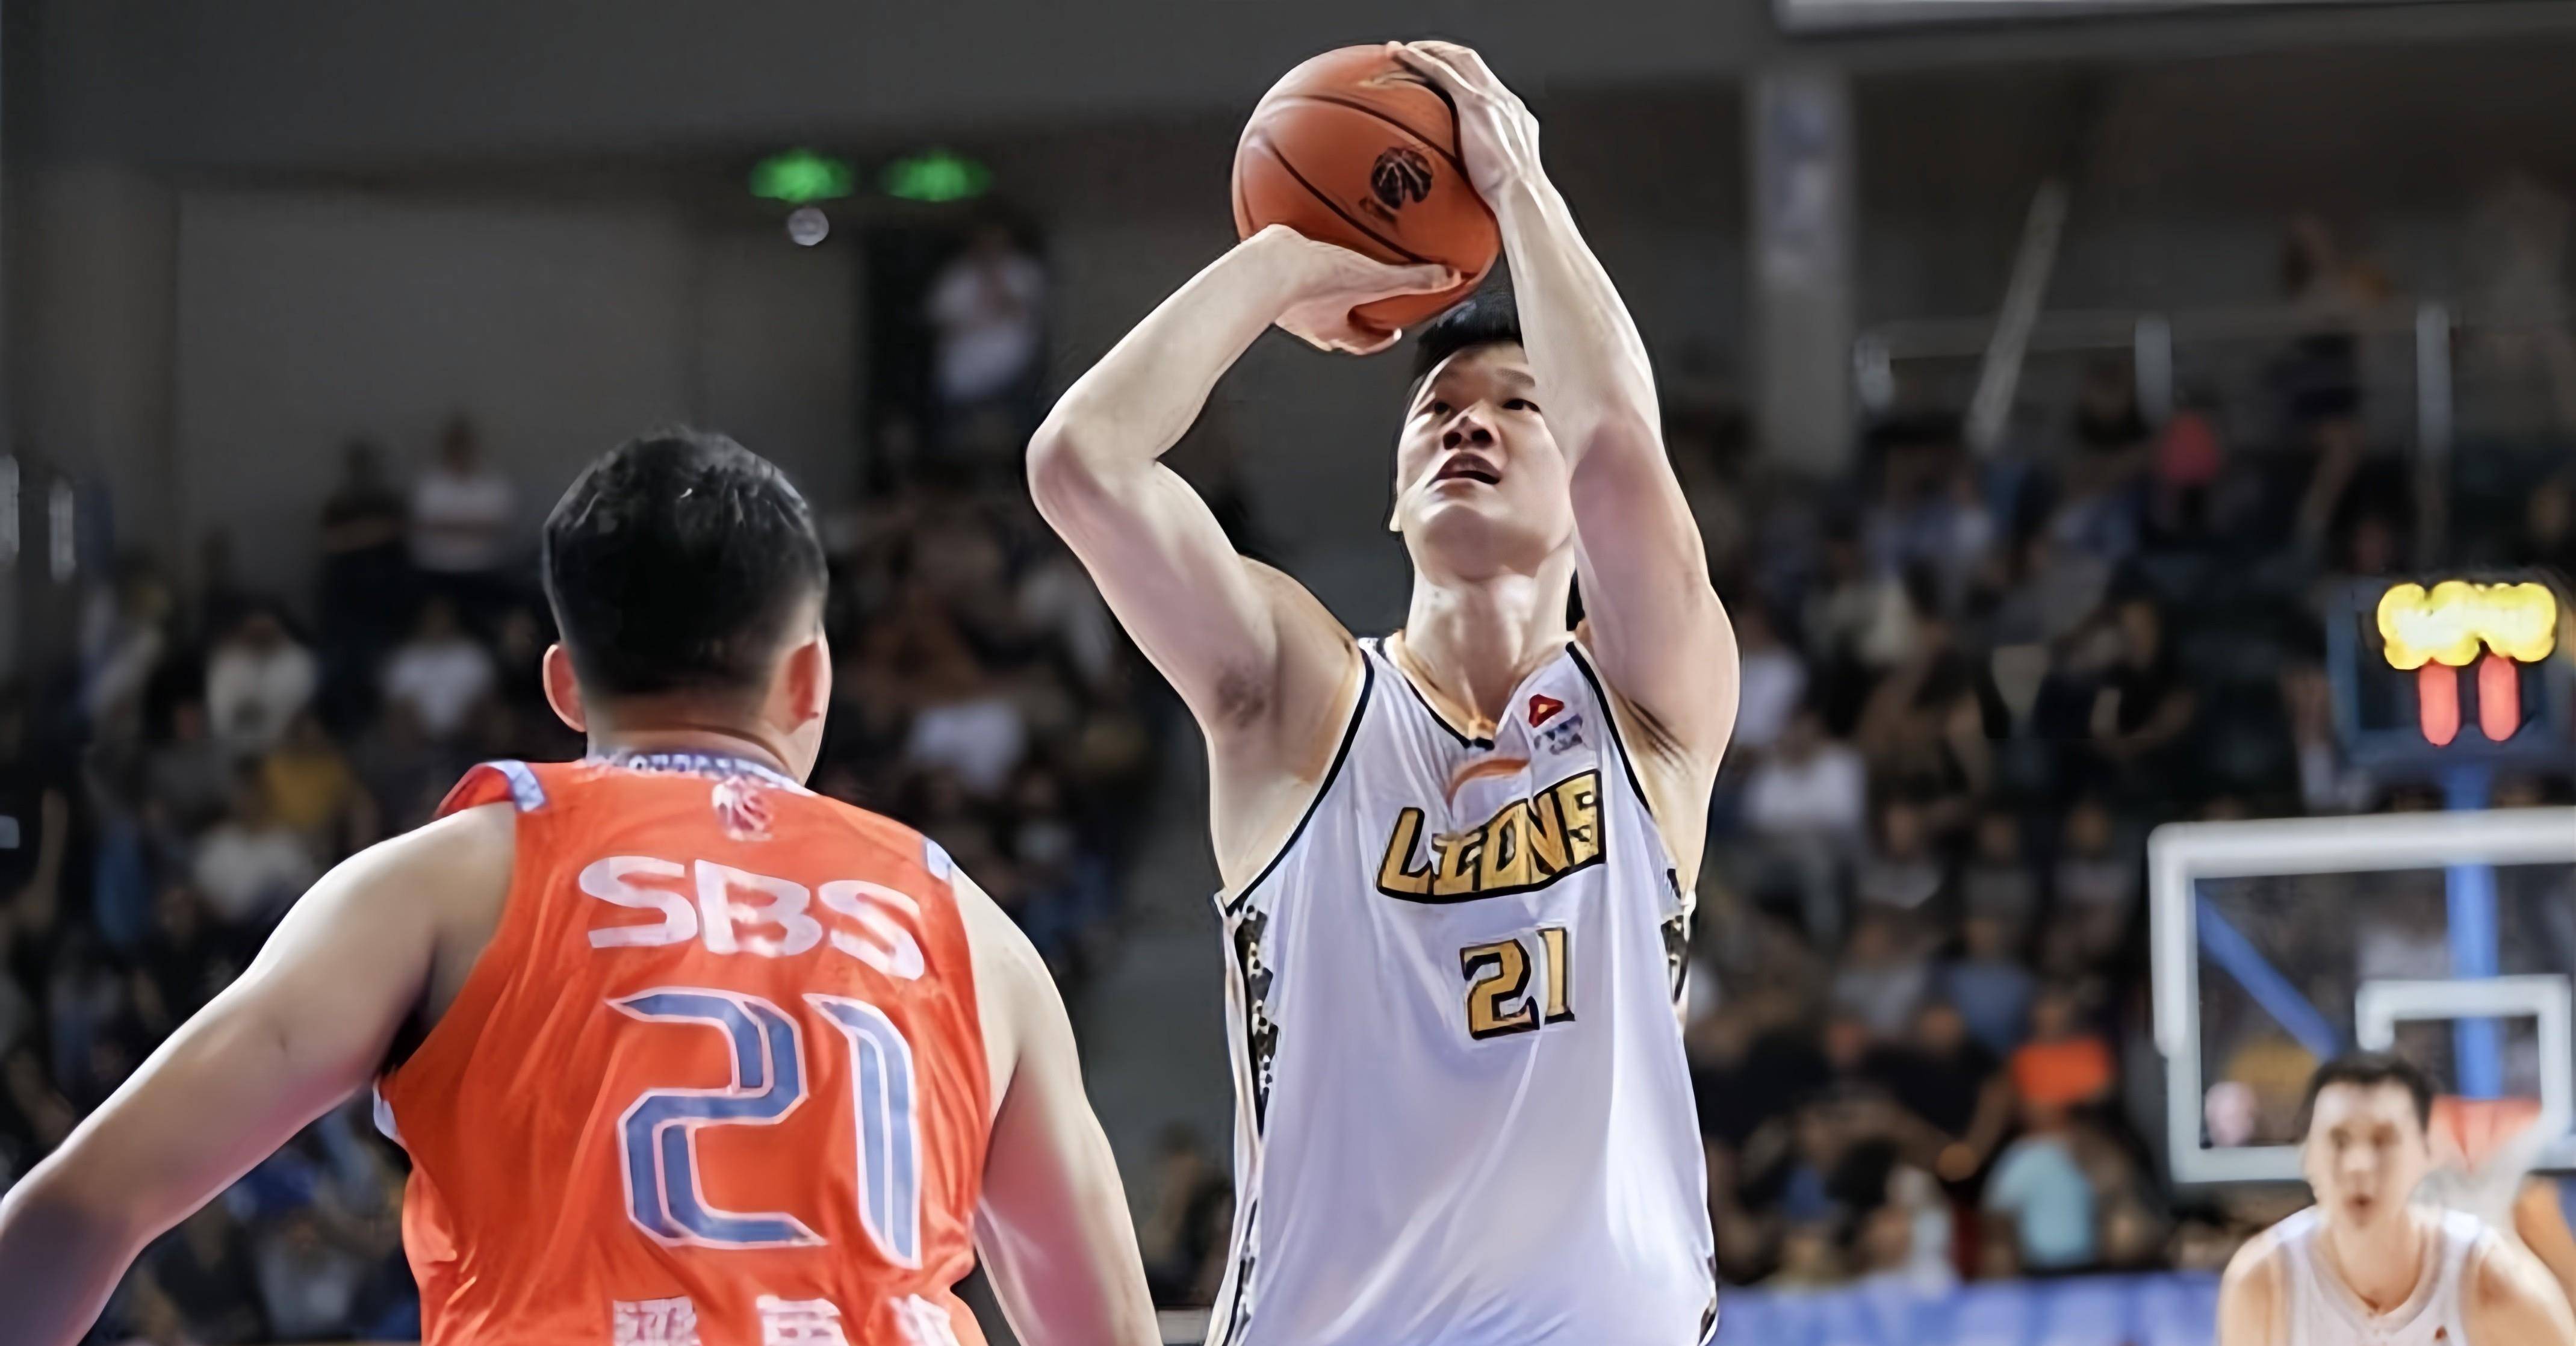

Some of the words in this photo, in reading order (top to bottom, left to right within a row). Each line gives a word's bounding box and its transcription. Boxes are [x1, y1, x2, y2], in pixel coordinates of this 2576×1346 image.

[1376, 769, 1607, 904] LIONS
[579, 856, 925, 981] SBS
[1459, 926, 1576, 1040] 21
[604, 986, 923, 1270] 21
